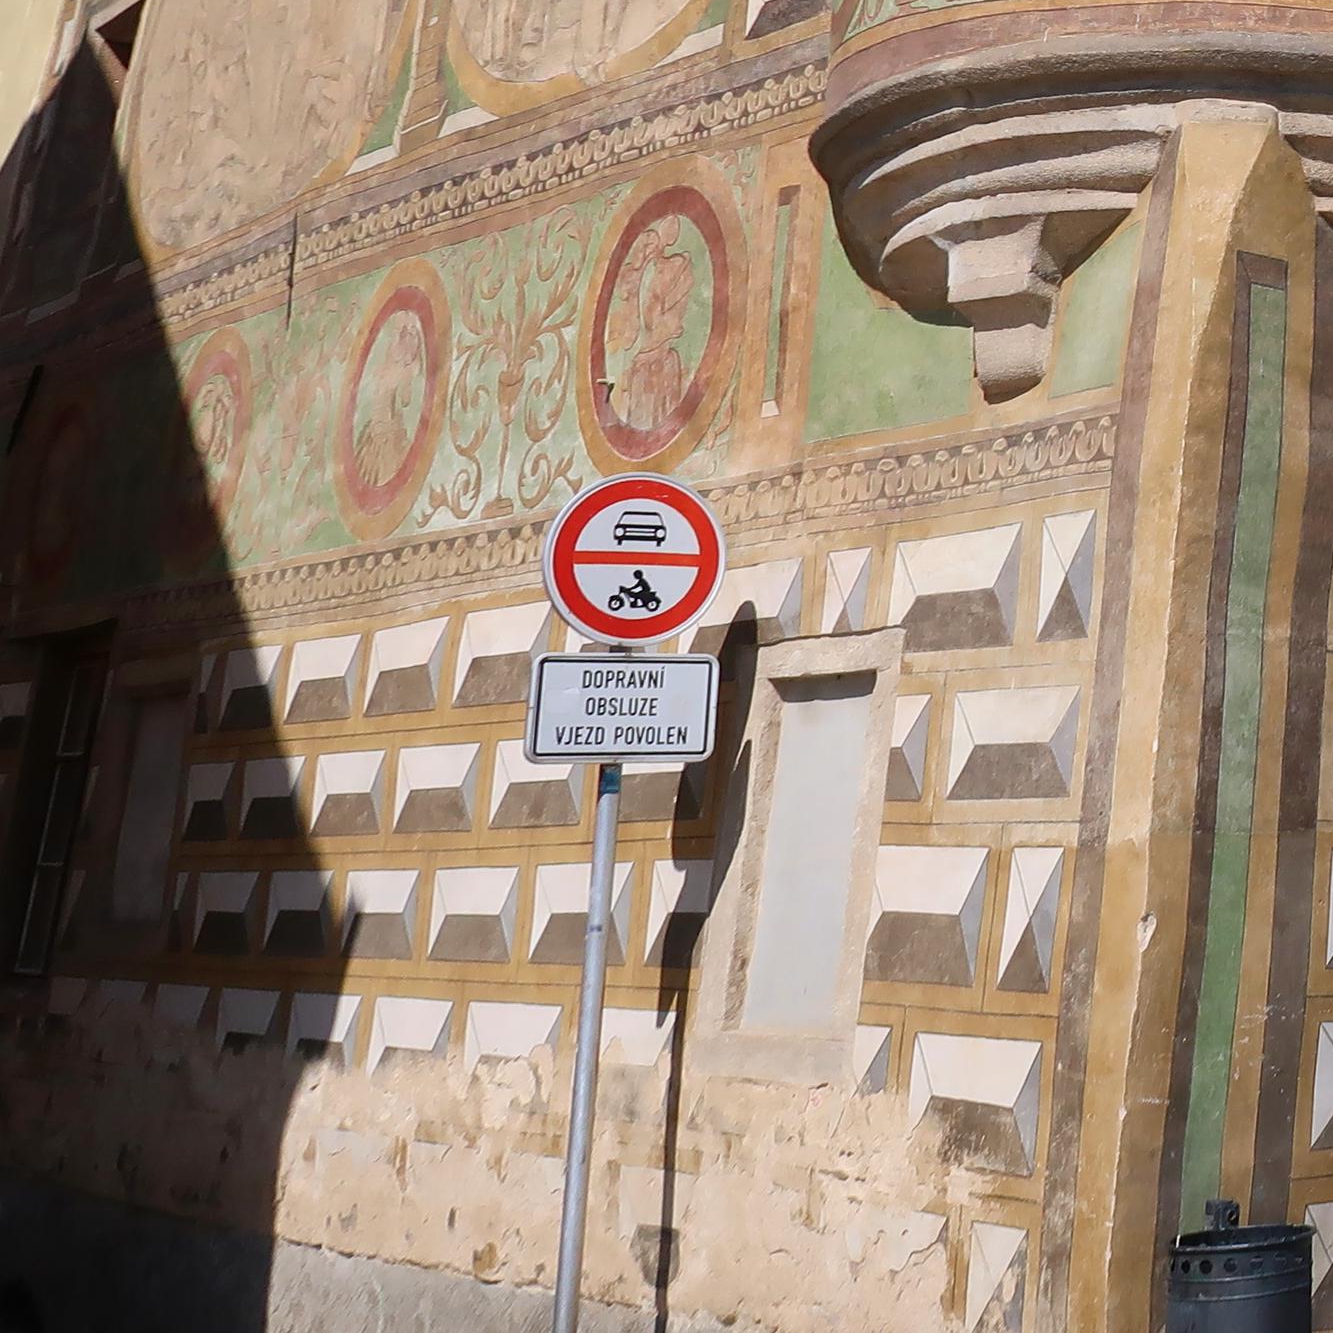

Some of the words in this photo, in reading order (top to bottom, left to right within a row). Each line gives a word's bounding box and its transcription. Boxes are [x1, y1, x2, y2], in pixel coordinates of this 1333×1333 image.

[581, 666, 665, 689] DOPRAVNÍ
[584, 696, 659, 717] OBSLUZE
[554, 725, 605, 746] VJEZD
[612, 725, 689, 746] POVOLEN
